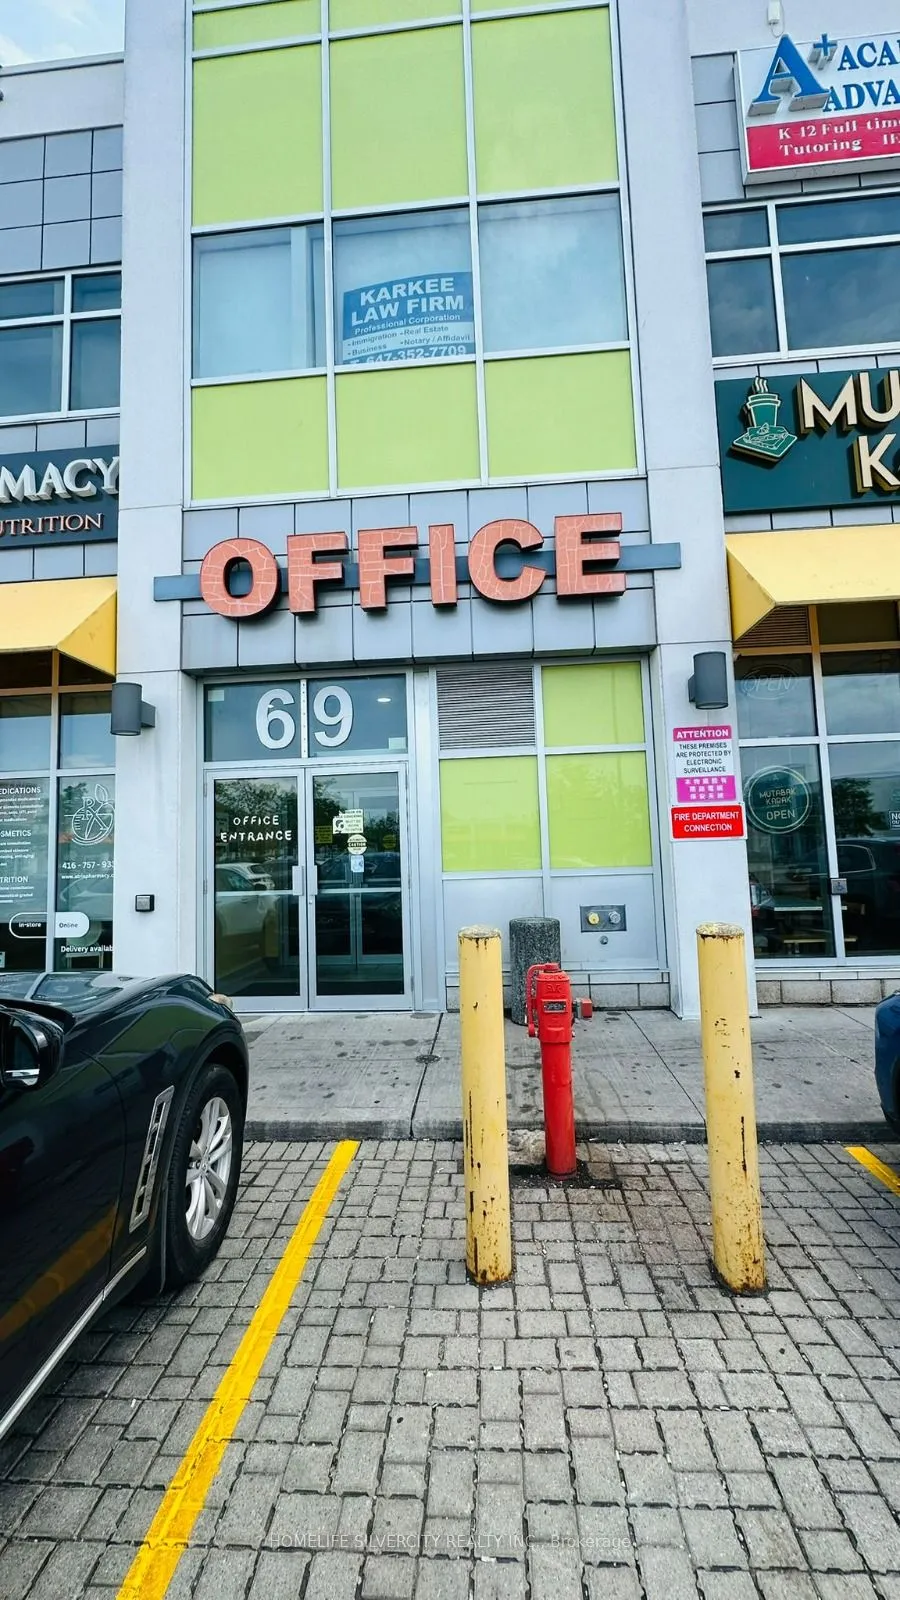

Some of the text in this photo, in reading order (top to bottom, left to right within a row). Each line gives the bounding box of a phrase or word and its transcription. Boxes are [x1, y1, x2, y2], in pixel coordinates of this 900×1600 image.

[837, 39, 900, 71] ACA
[779, 138, 862, 156] Tutoring
[360, 277, 454, 306] KARKEE
[351, 295, 464, 327] LAW FIRM
[354, 314, 461, 335] Professional Corporation
[423, 325, 449, 334] Estate
[857, 433, 900, 489] K
[199, 512, 627, 619] OFFICE
[255, 685, 354, 750] 69
[676, 729, 729, 739] ATTENTION
[233, 815, 280, 826] OFFICE
[692, 811, 740, 820] DEPARTMENT
[766, 810, 796, 820] OPEN
[684, 824, 732, 832] CONNECTION
[220, 830, 292, 843] ENTRANCE
[62, 861, 77, 869] 416
[82, 861, 96, 869] 757
[60, 945, 88, 953] Delivery
